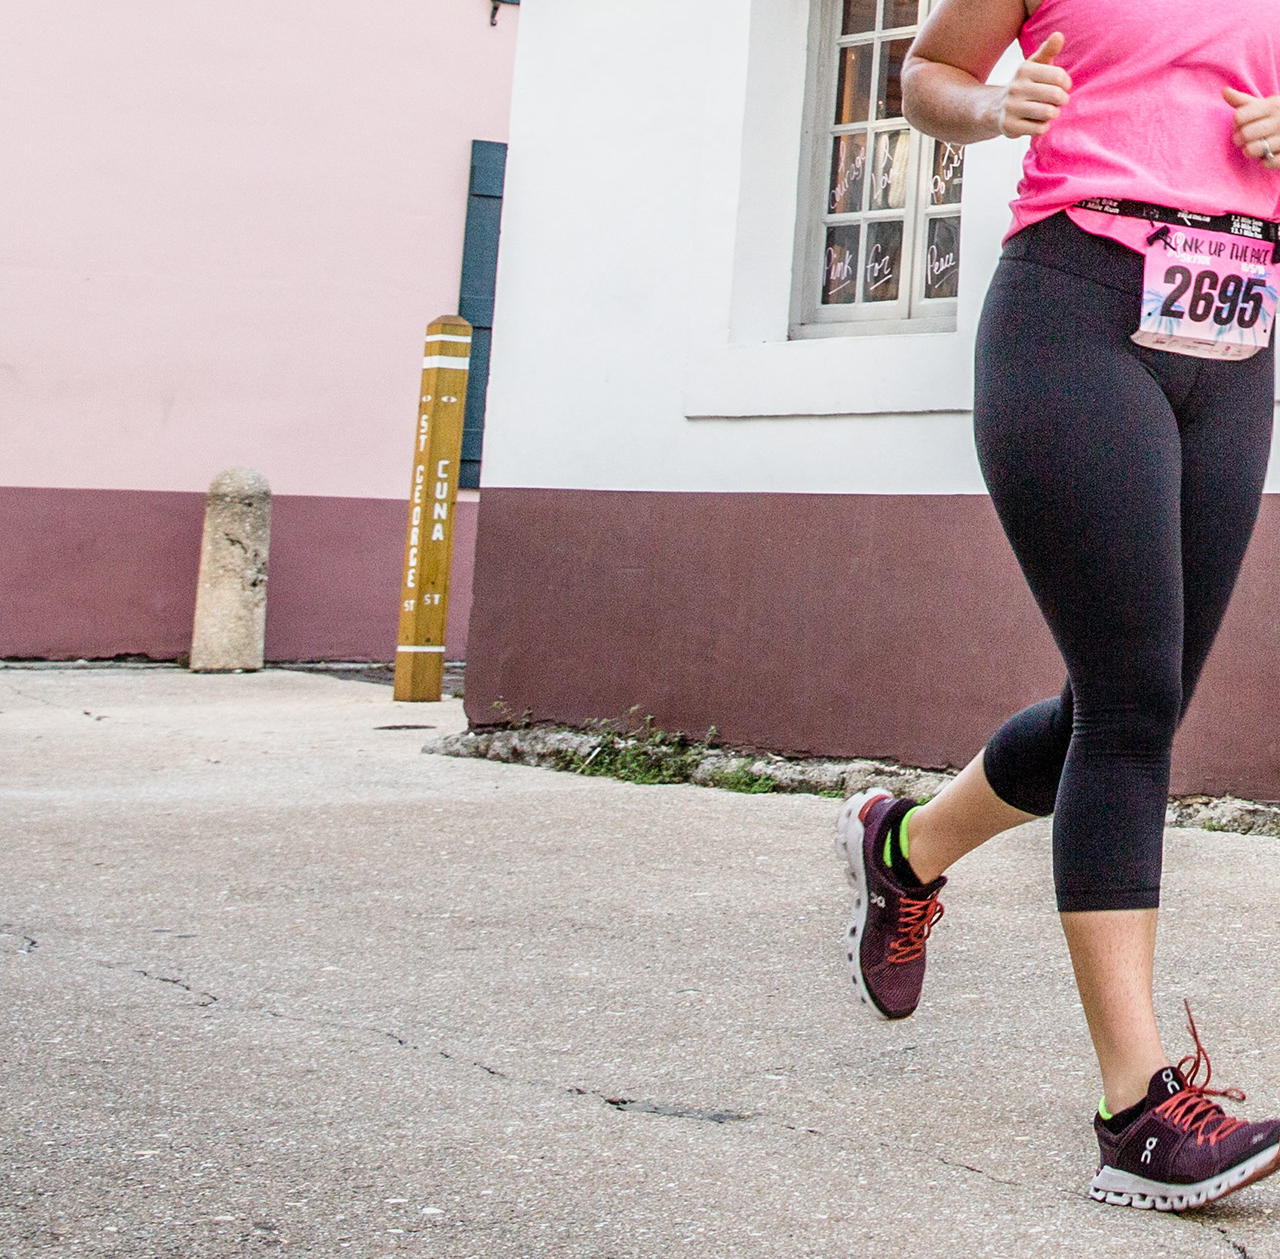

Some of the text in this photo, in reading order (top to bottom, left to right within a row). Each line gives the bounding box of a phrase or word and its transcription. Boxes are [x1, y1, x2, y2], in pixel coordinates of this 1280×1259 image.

[1208, 241, 1226, 258] UP
[1230, 244, 1250, 263] THE
[1159, 265, 1267, 329] 2695
[406, 463, 425, 589] GEORGE
[431, 459, 450, 541] CUNA
